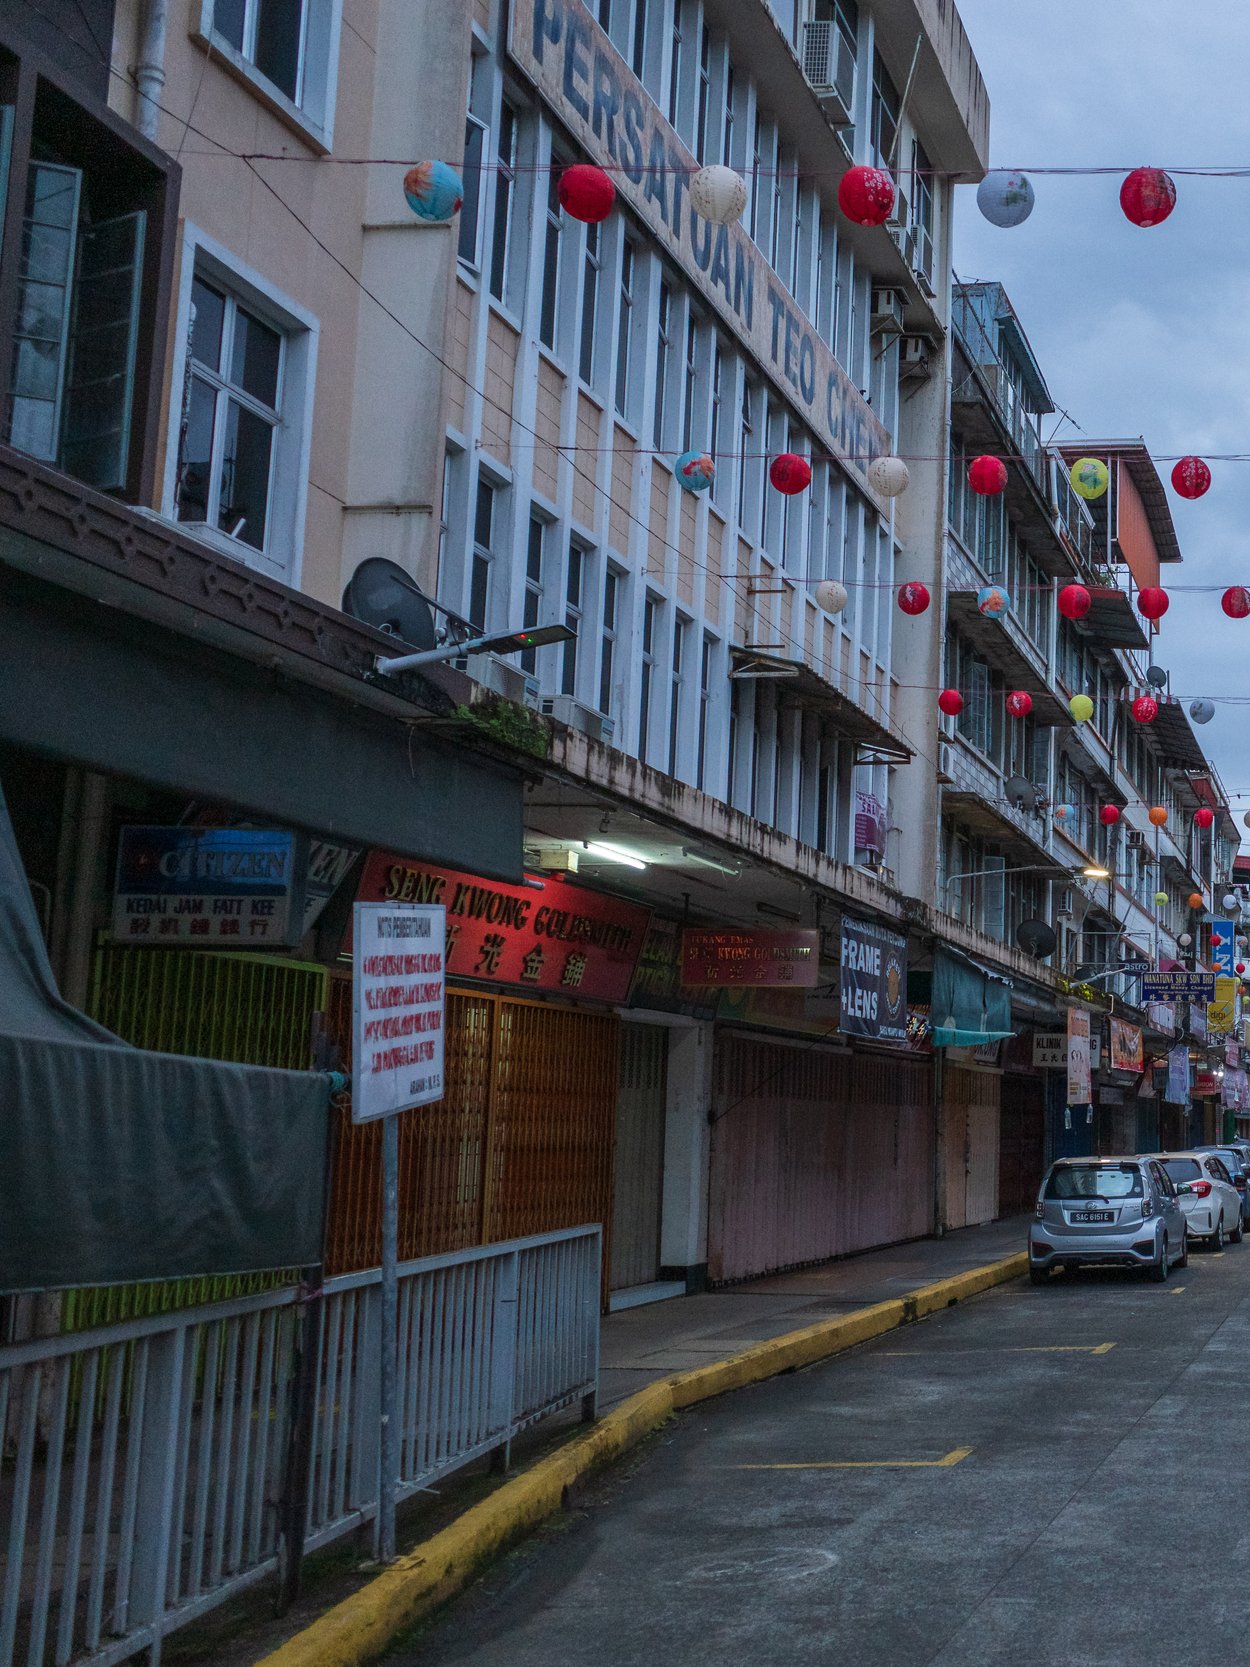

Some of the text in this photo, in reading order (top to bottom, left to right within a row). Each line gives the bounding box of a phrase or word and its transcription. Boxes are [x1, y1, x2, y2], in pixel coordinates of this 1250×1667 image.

[768, 286, 815, 406] TEO
[160, 851, 288, 878] CITIZEN
[126, 898, 166, 914] KEDAI
[174, 898, 203, 913] JAM
[251, 899, 275, 915] KEE
[449, 882, 530, 929] KWONG
[730, 935, 753, 944] EMAS
[841, 937, 880, 974] FRAME
[1124, 962, 1148, 970] astro
[1190, 974, 1200, 984] SDN
[1203, 974, 1214, 984] BHD
[1036, 1037, 1061, 1049] KLINIK
[1075, 1213, 1109, 1221] SAC 6151 E
